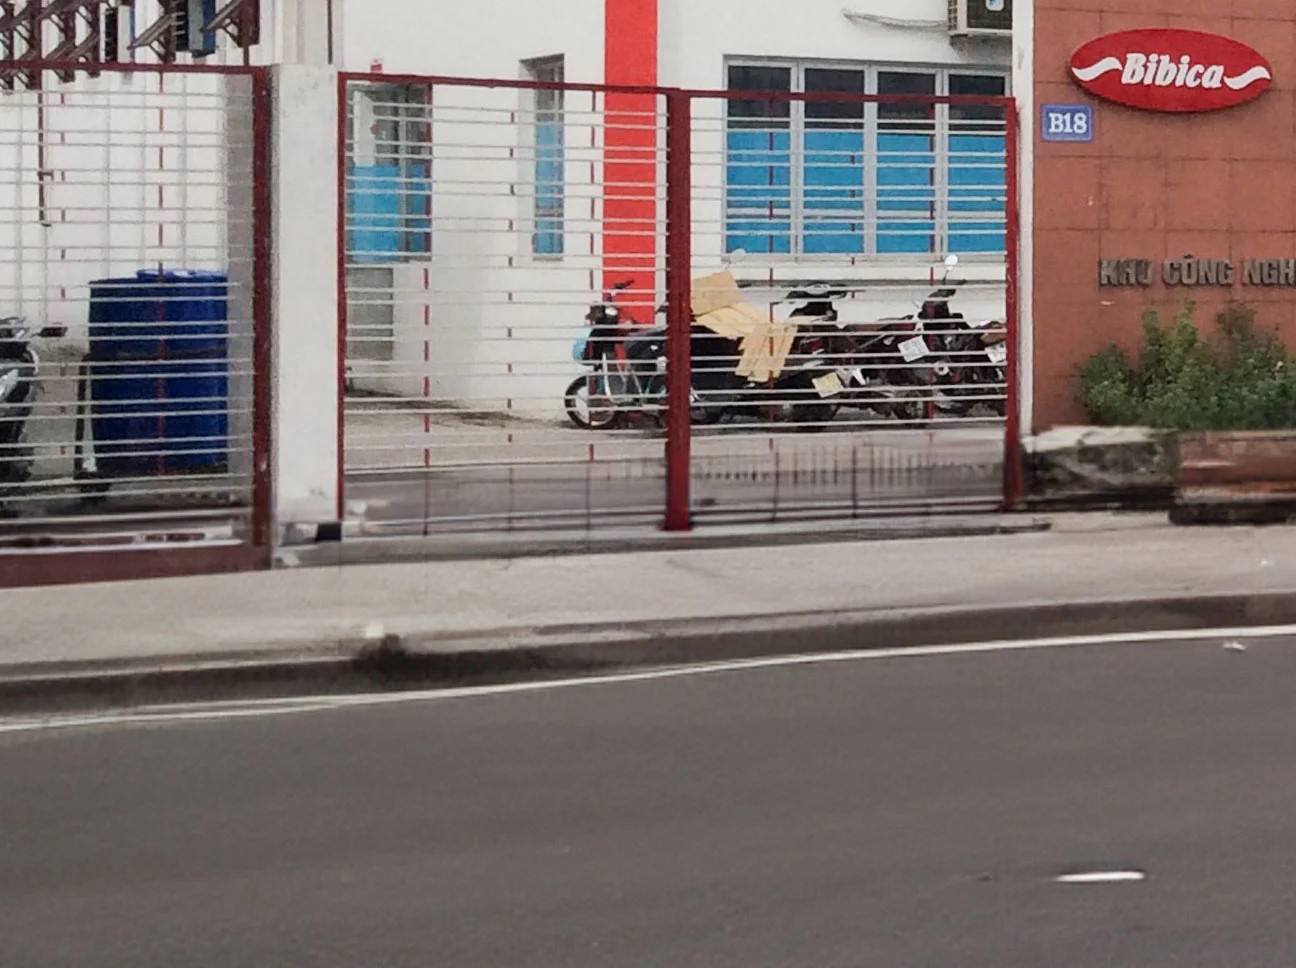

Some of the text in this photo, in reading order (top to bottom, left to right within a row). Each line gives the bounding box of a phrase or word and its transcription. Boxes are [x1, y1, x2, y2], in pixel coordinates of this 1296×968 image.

[1121, 52, 1224, 89] Bibica
[1048, 112, 1087, 133] B18
[1099, 259, 1152, 287] KHU
[1162, 254, 1234, 286] CÔNG
